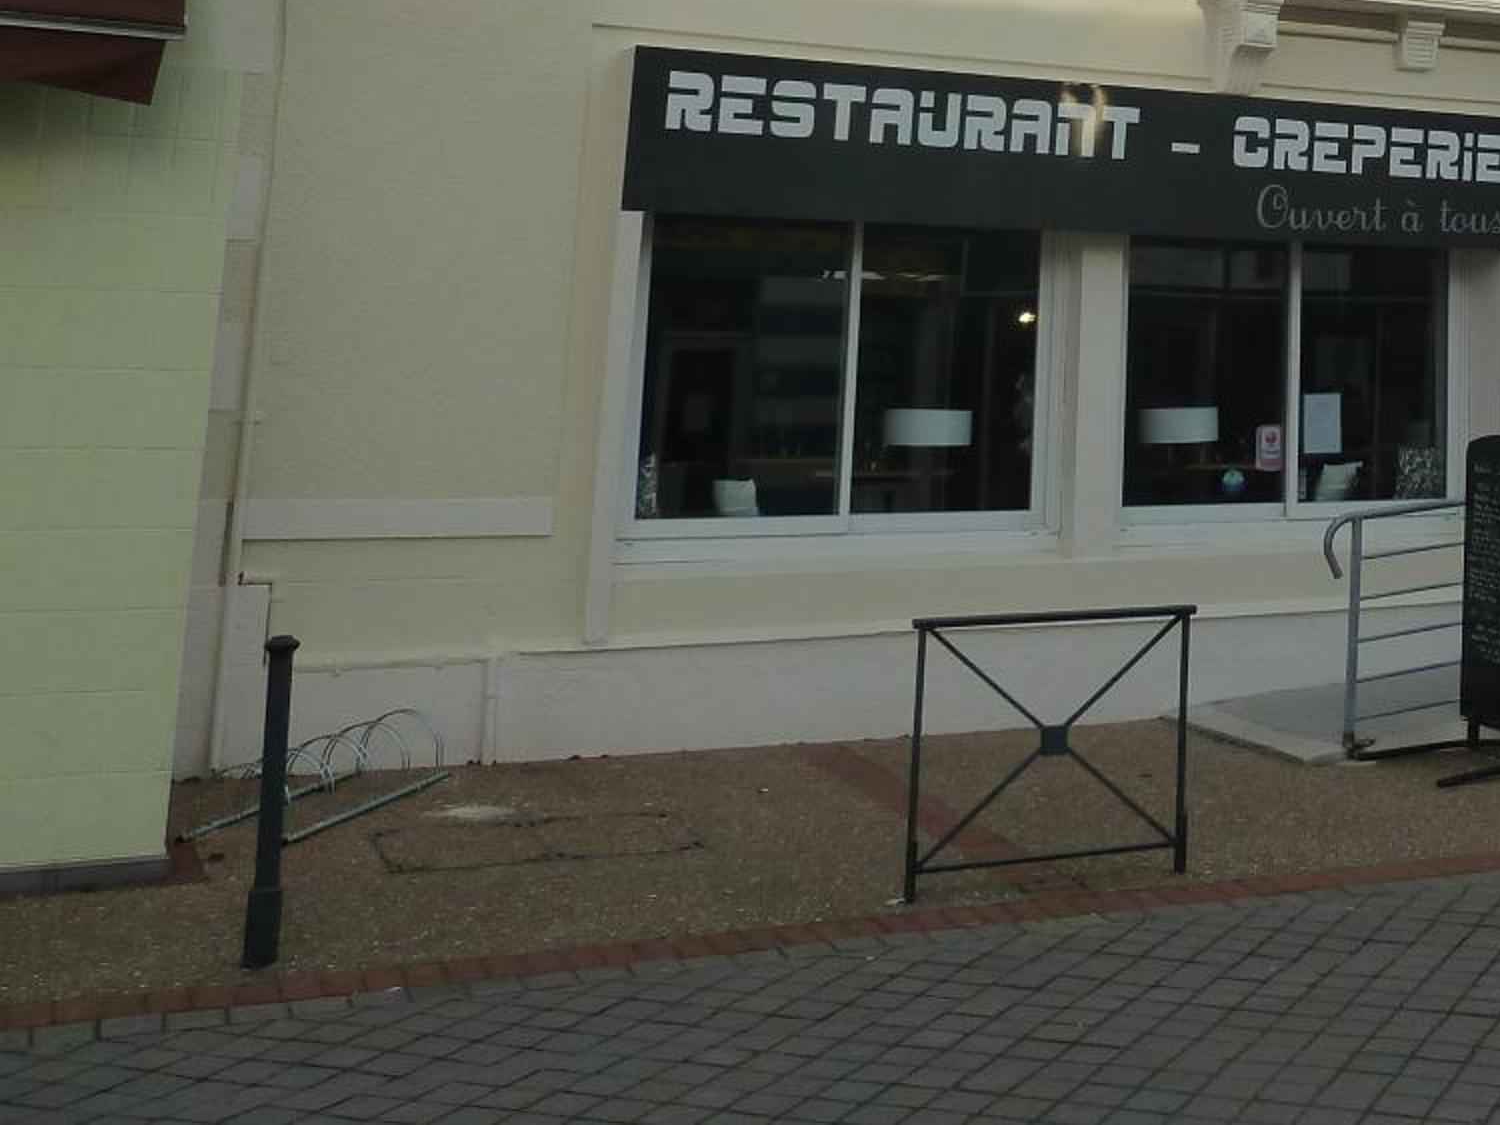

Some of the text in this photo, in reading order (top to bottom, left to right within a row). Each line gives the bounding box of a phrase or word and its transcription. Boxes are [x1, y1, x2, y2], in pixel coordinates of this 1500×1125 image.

[664, 70, 1141, 161] RESTAURANT
[1257, 184, 1387, 232] Ouvert
[1401, 200, 1424, 233] à
